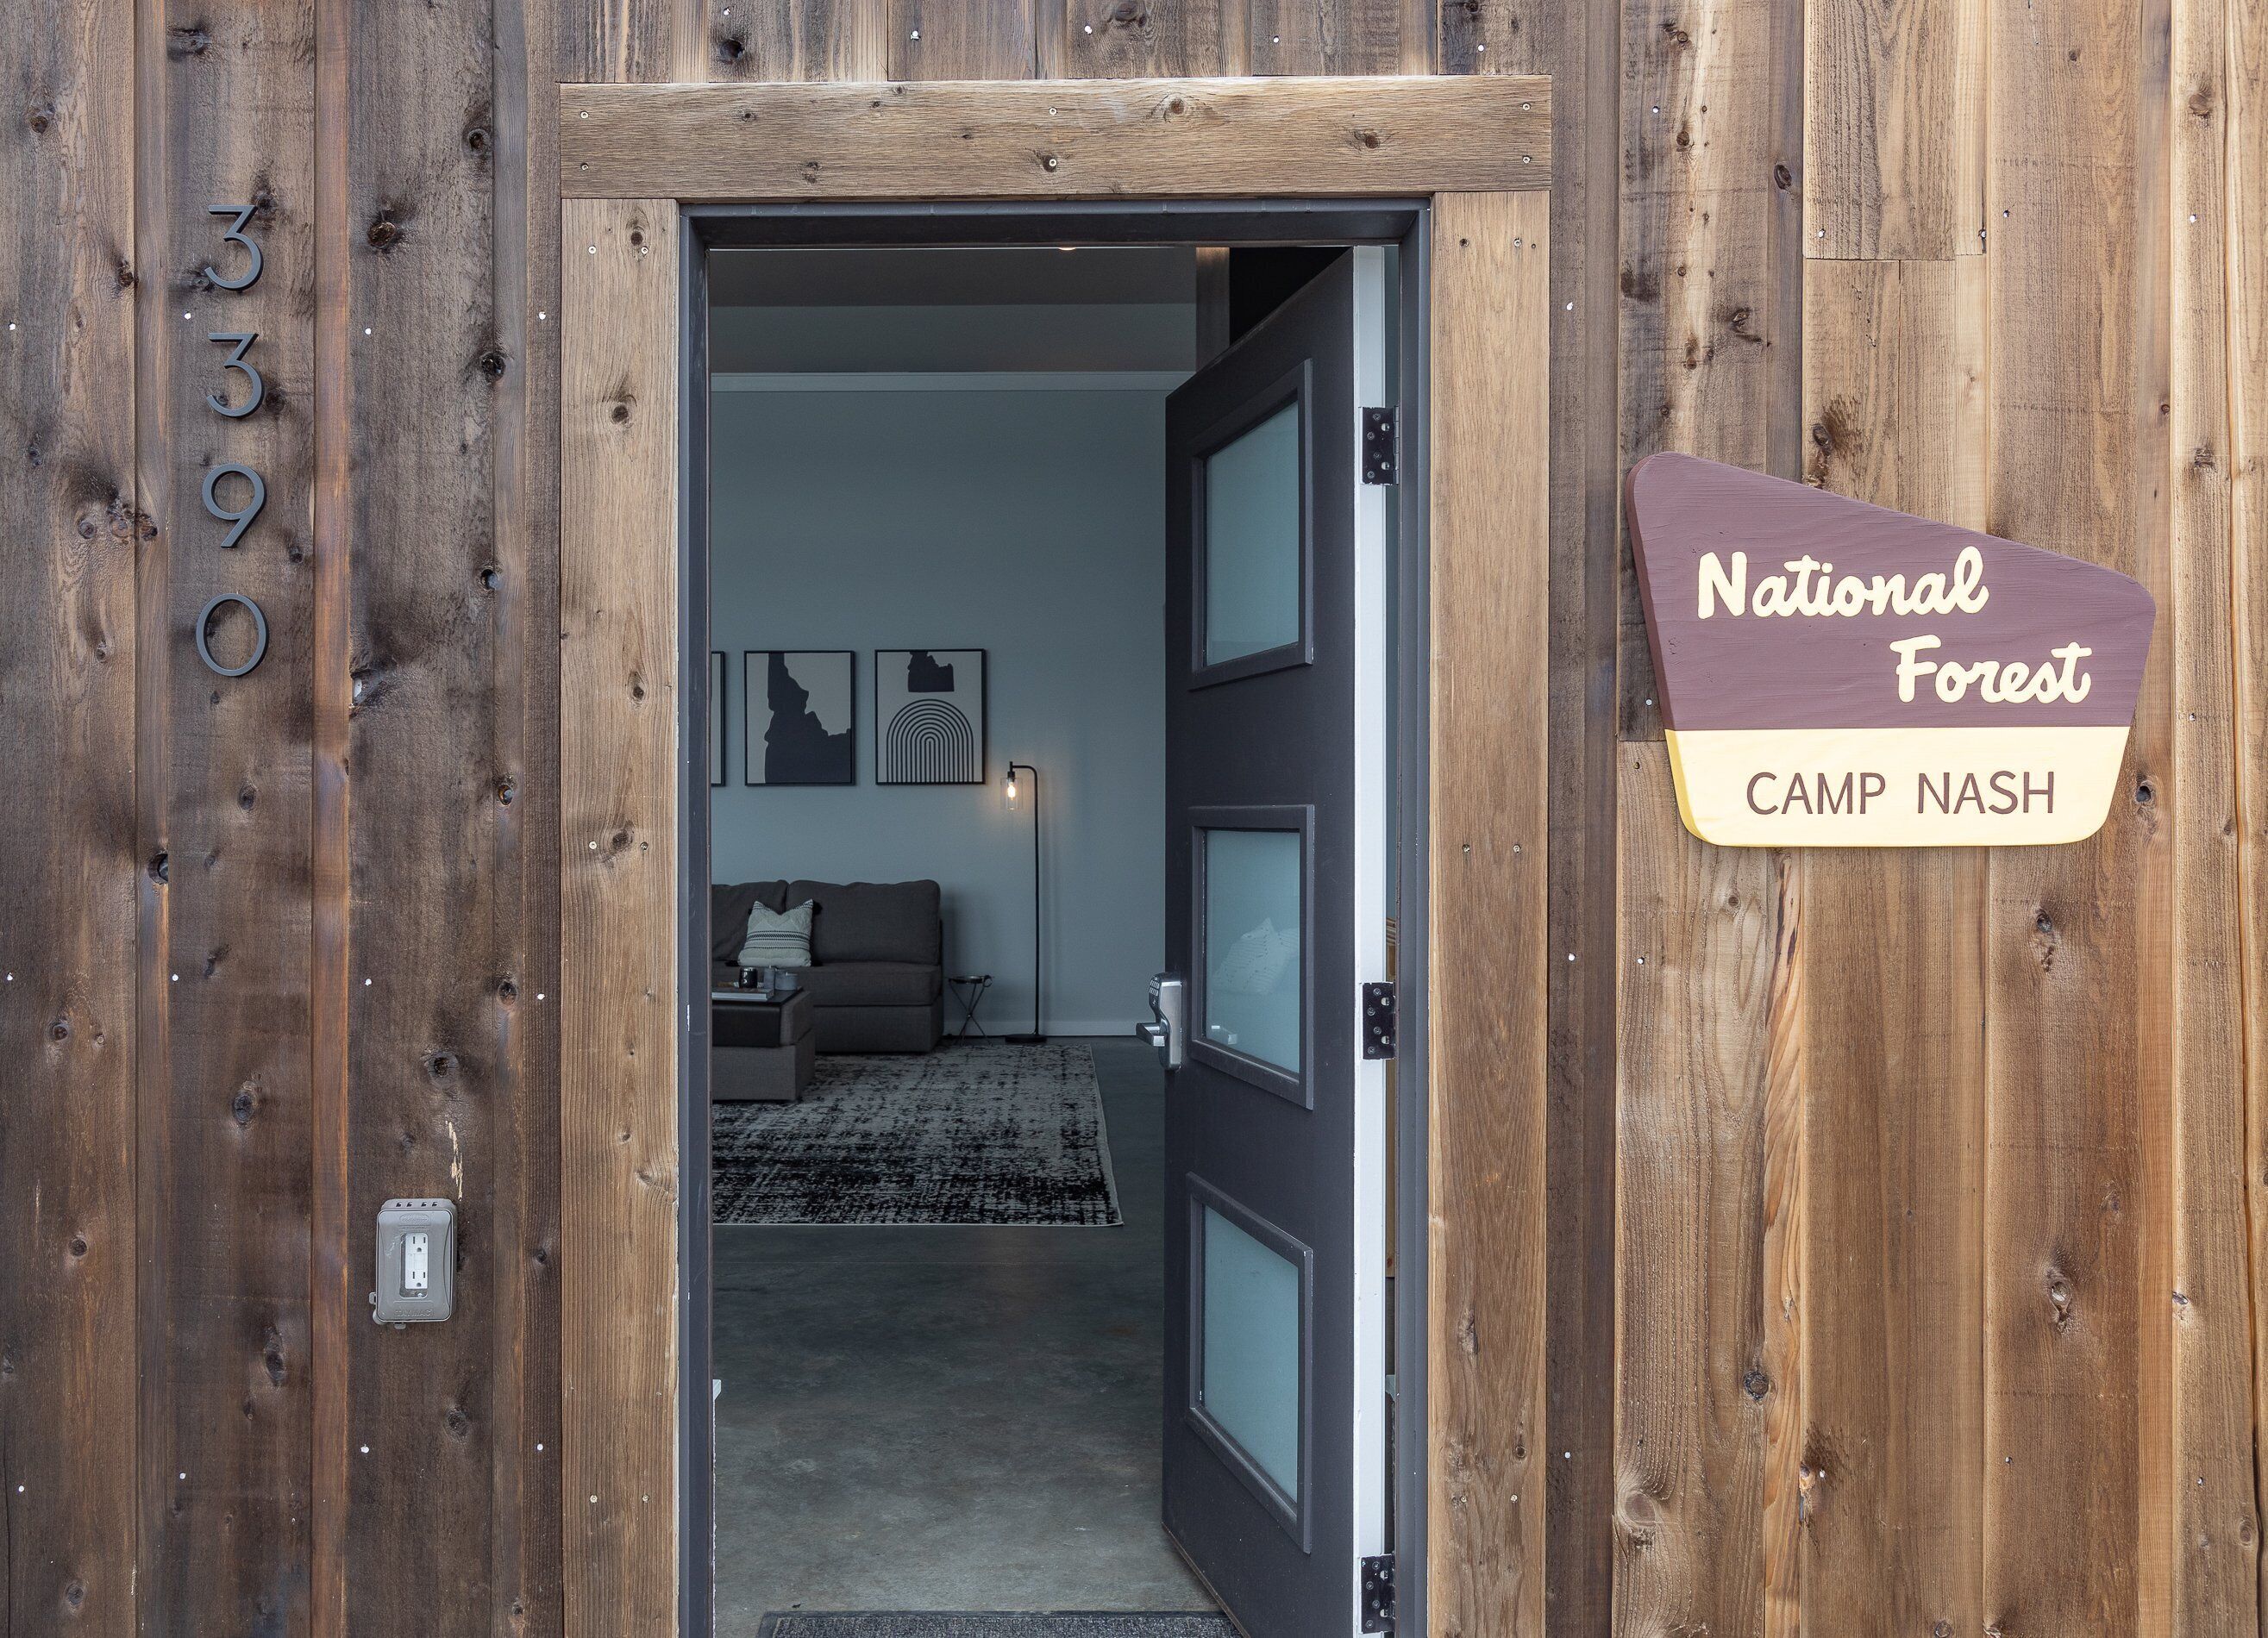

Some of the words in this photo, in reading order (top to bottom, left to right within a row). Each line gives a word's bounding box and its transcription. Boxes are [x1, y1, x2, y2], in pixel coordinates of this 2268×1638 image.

[196, 204, 269, 678] 3390
[1697, 546, 1989, 620] National
[1889, 634, 2093, 704] Forest
[1746, 771, 1887, 816] CAMP
[1917, 770, 2054, 816] NASH
